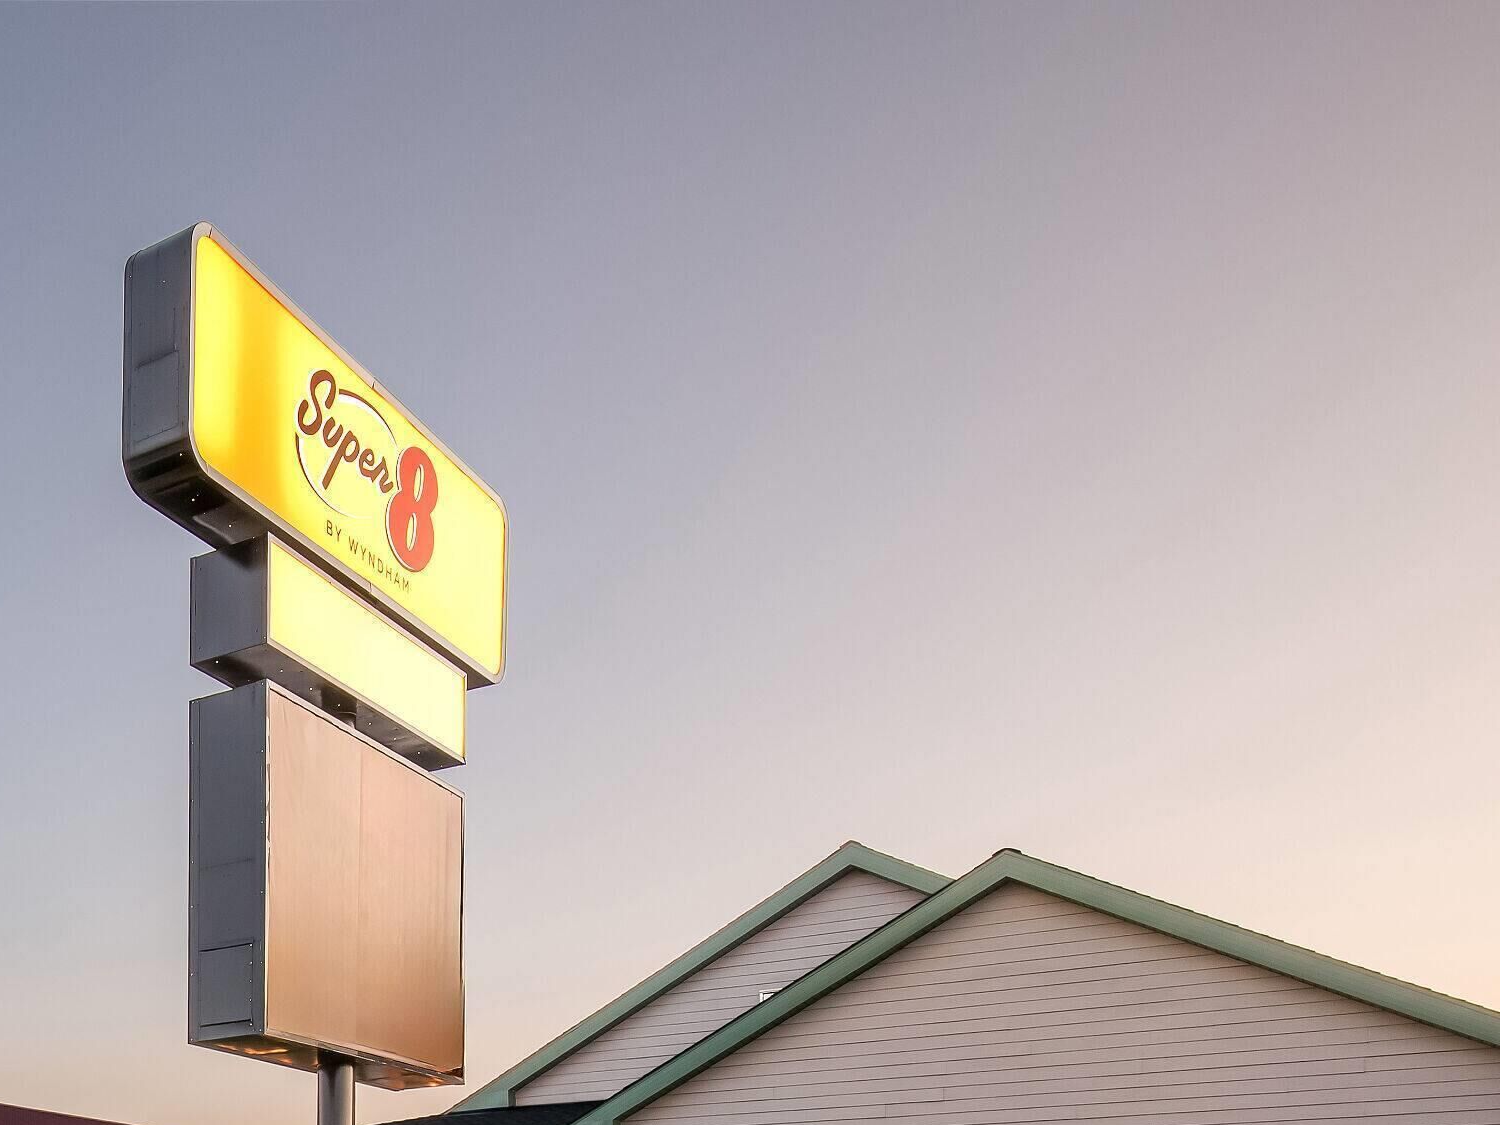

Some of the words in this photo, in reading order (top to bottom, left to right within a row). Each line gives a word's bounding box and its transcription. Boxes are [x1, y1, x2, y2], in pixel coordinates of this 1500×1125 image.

[297, 369, 394, 494] Super
[385, 446, 438, 573] 8
[325, 519, 342, 542] BY
[348, 536, 410, 593] WYNDHAM
